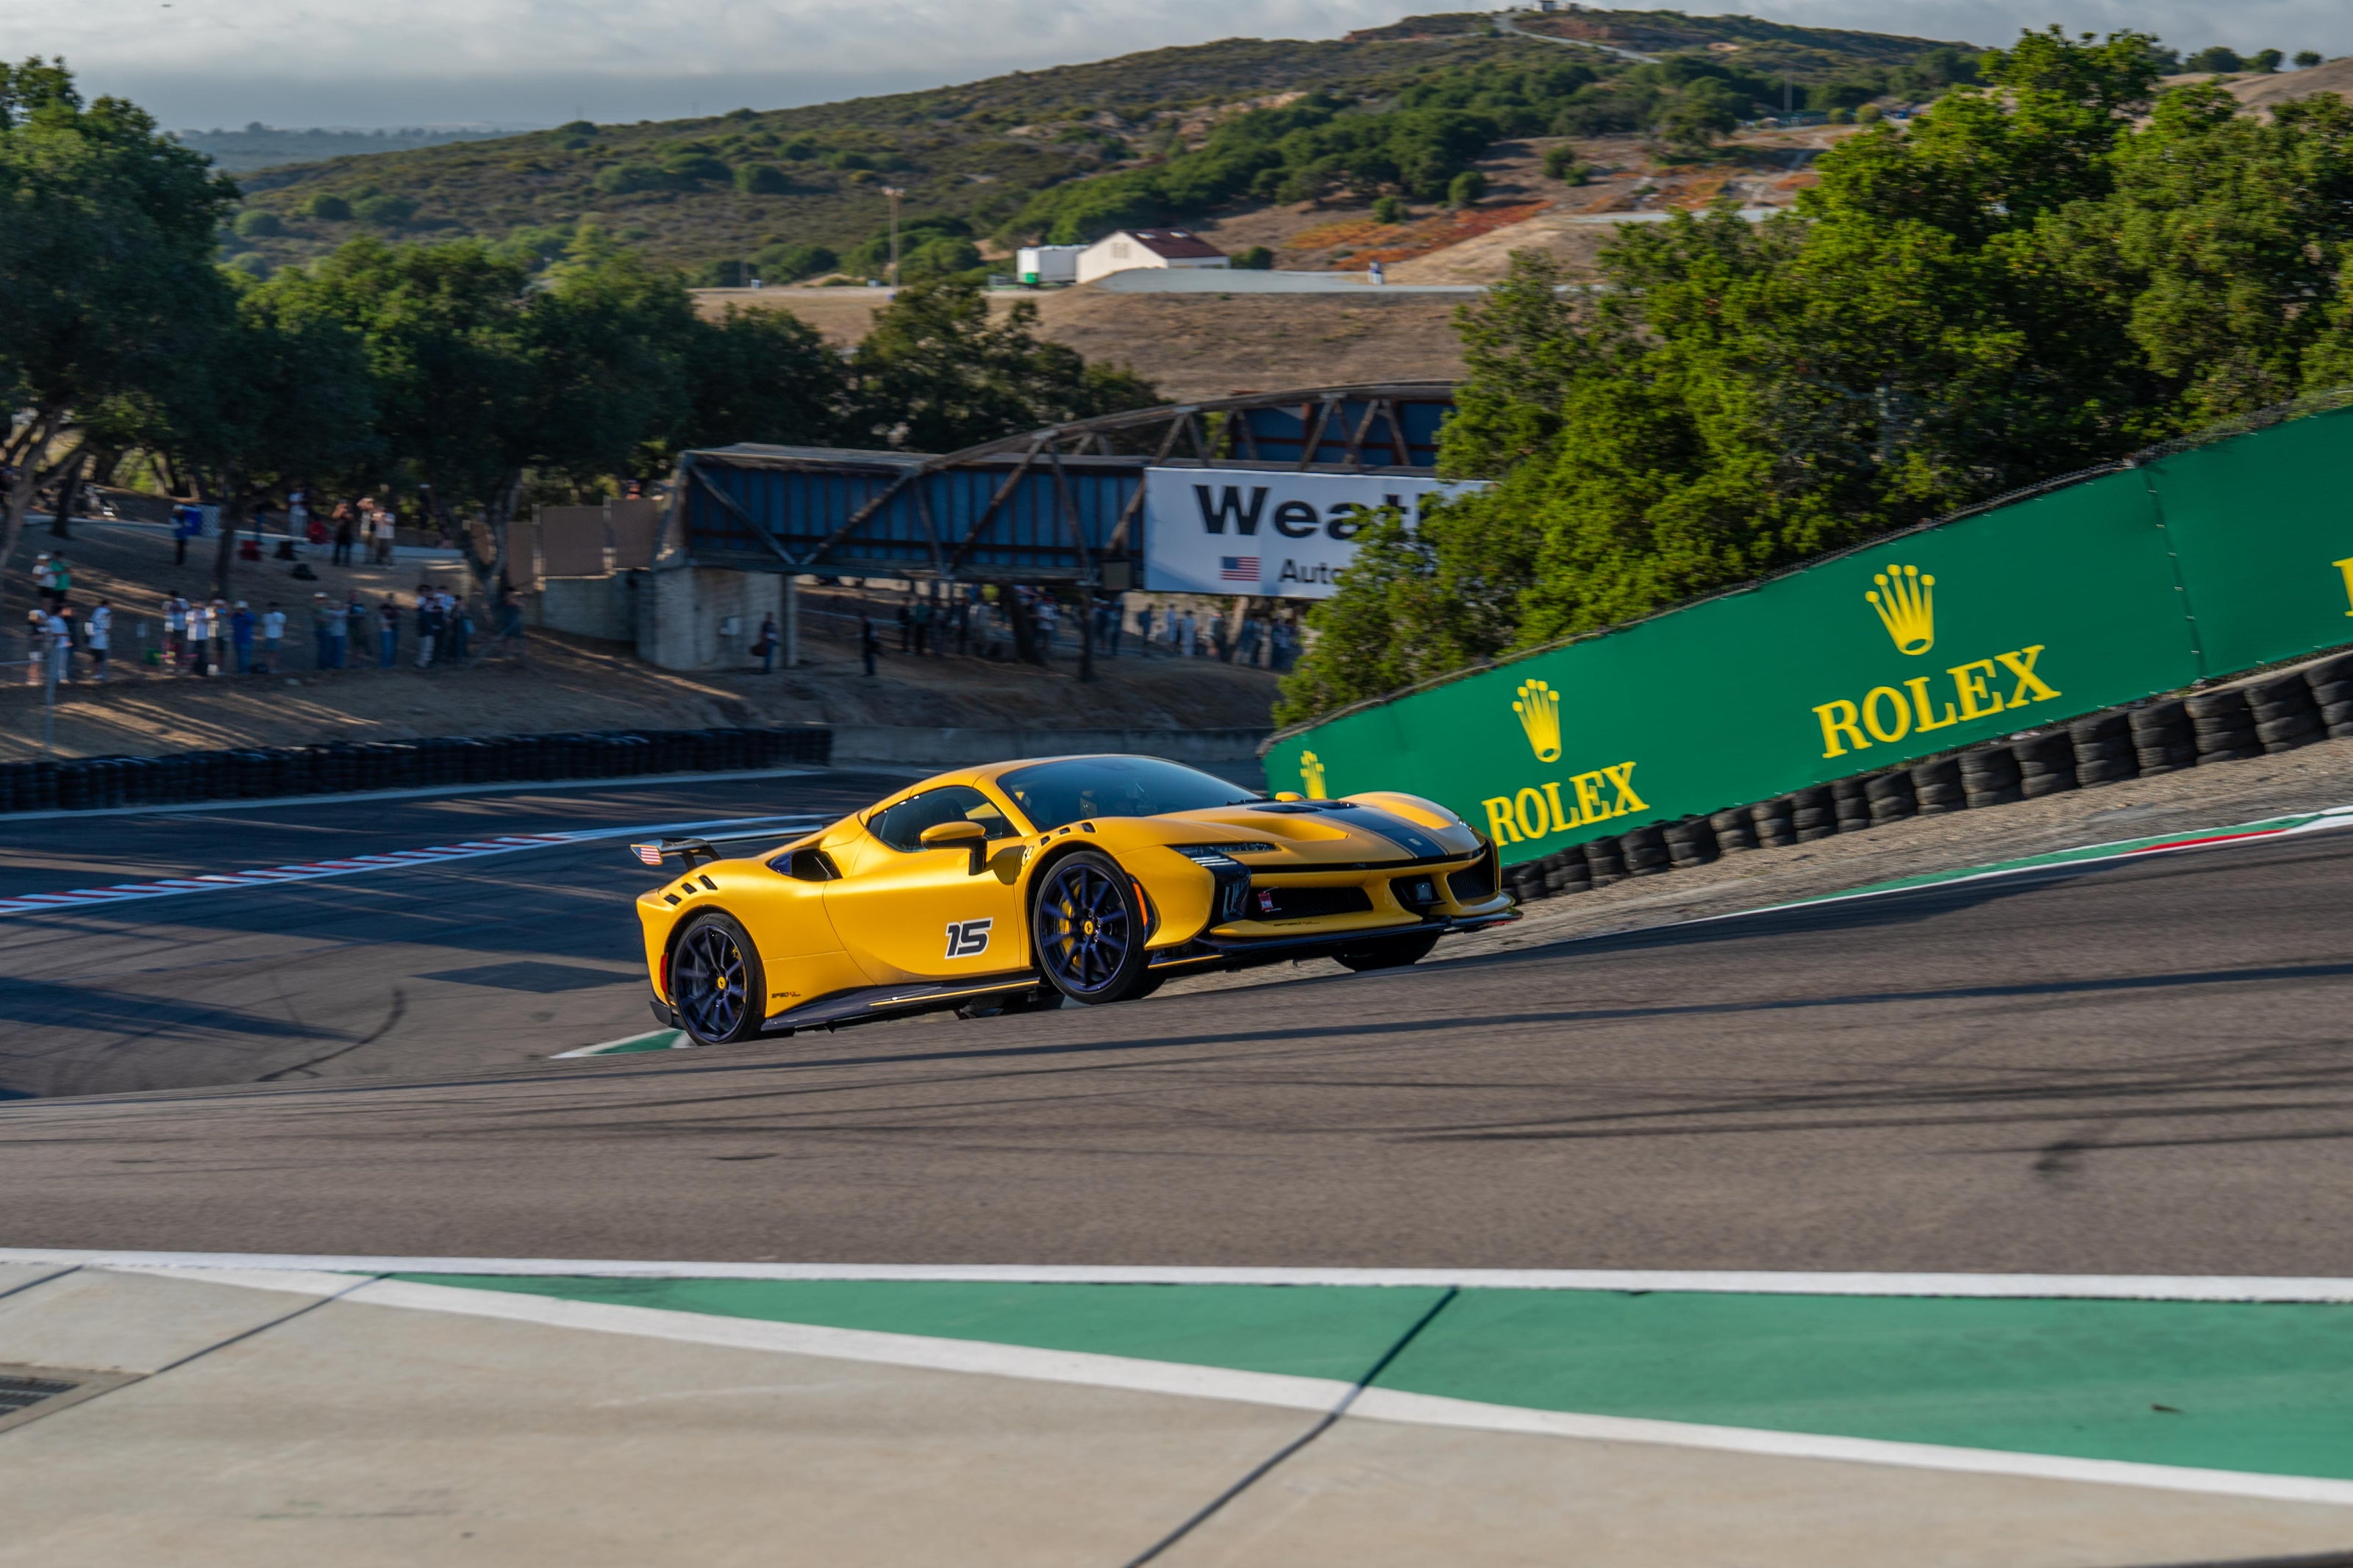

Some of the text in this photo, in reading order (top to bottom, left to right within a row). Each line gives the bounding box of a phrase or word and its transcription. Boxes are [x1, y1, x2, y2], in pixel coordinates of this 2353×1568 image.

[1812, 644, 2063, 759] ROLEX
[1481, 761, 1651, 847] ROLEX
[944, 917, 993, 960] 15
